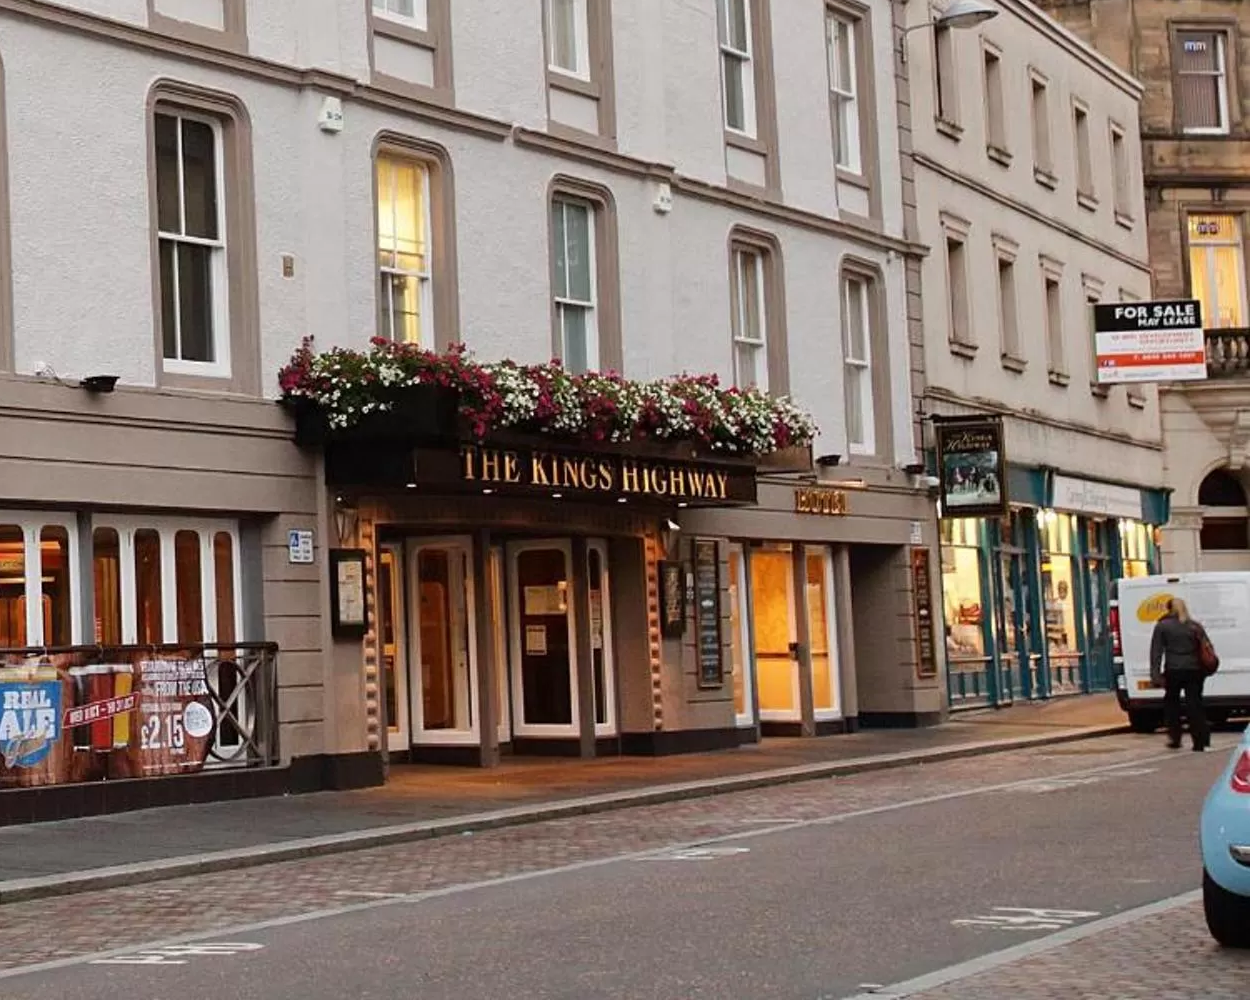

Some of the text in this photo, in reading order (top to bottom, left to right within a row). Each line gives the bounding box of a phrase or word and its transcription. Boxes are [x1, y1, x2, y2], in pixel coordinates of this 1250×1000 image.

[1114, 304, 1195, 319] FOR SALE
[1138, 316, 1196, 328] MAY LEASE
[460, 445, 729, 499] THE KINGS HIGHWAY
[794, 488, 852, 515] HOTEL
[3, 690, 51, 709] REAL
[141, 714, 184, 749] £2.15
